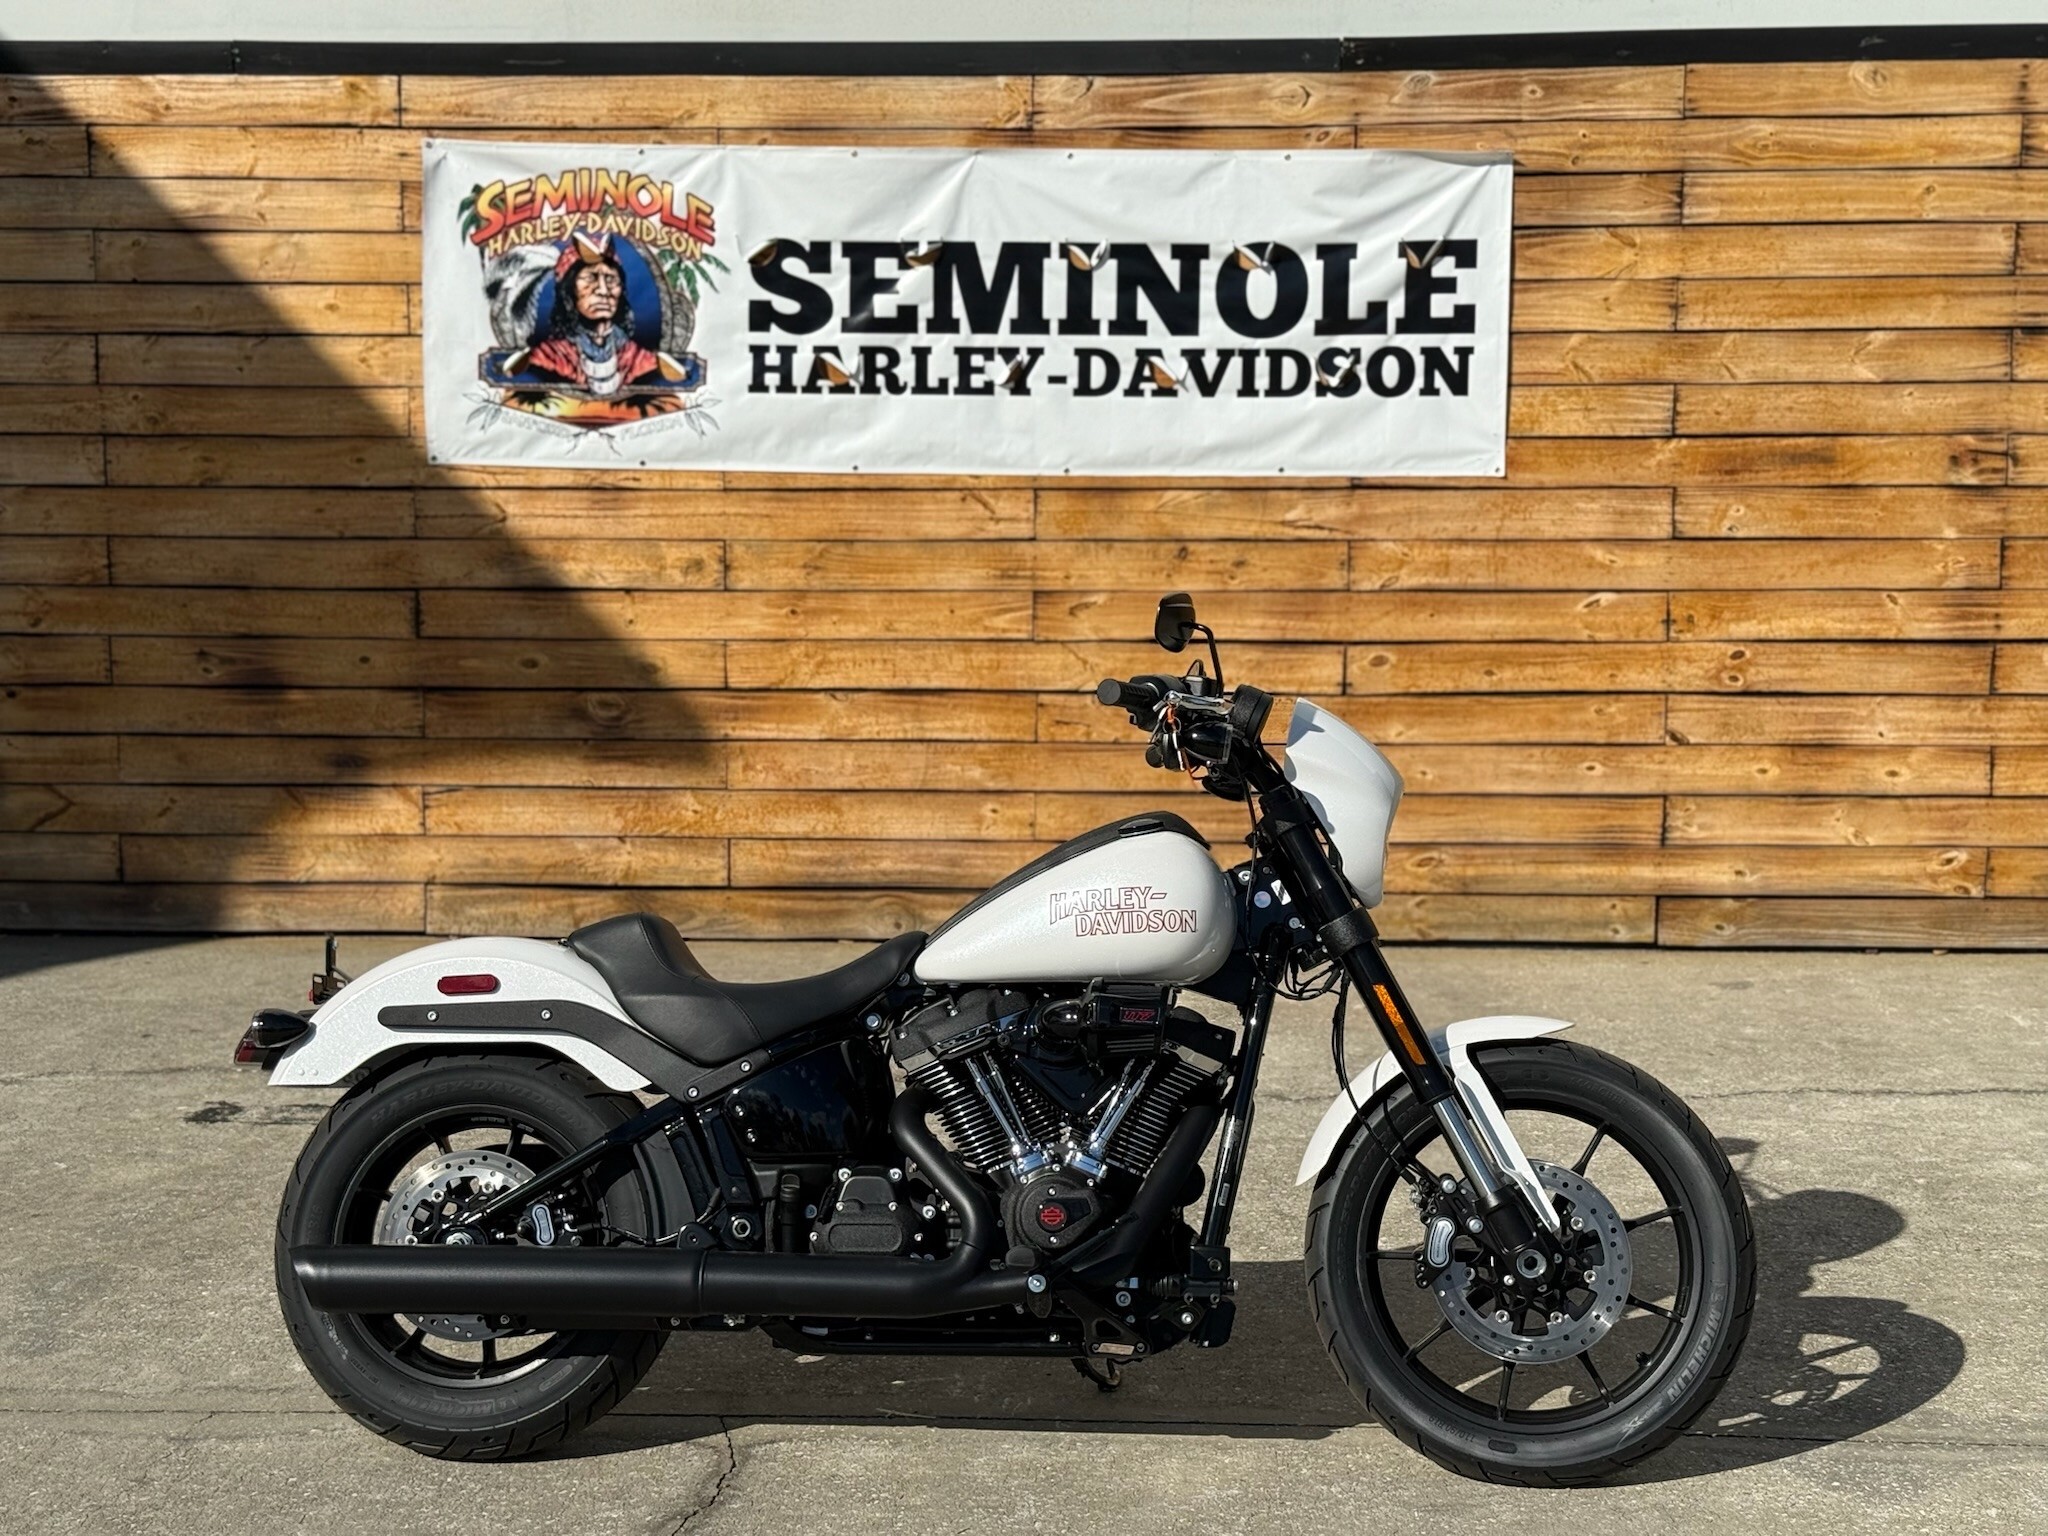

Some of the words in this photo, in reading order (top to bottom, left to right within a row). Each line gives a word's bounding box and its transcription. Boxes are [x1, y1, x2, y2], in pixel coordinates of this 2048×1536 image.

[470, 168, 716, 246] SEMINOLE
[487, 211, 704, 261] HARLEY-DAVIDSON
[747, 237, 1479, 339] SEMINOLE
[746, 343, 1475, 398] HARLEY-DAVIDSON
[1074, 909, 1197, 937] DAVIDSON
[1666, 1307, 1722, 1403] MICHELIN
